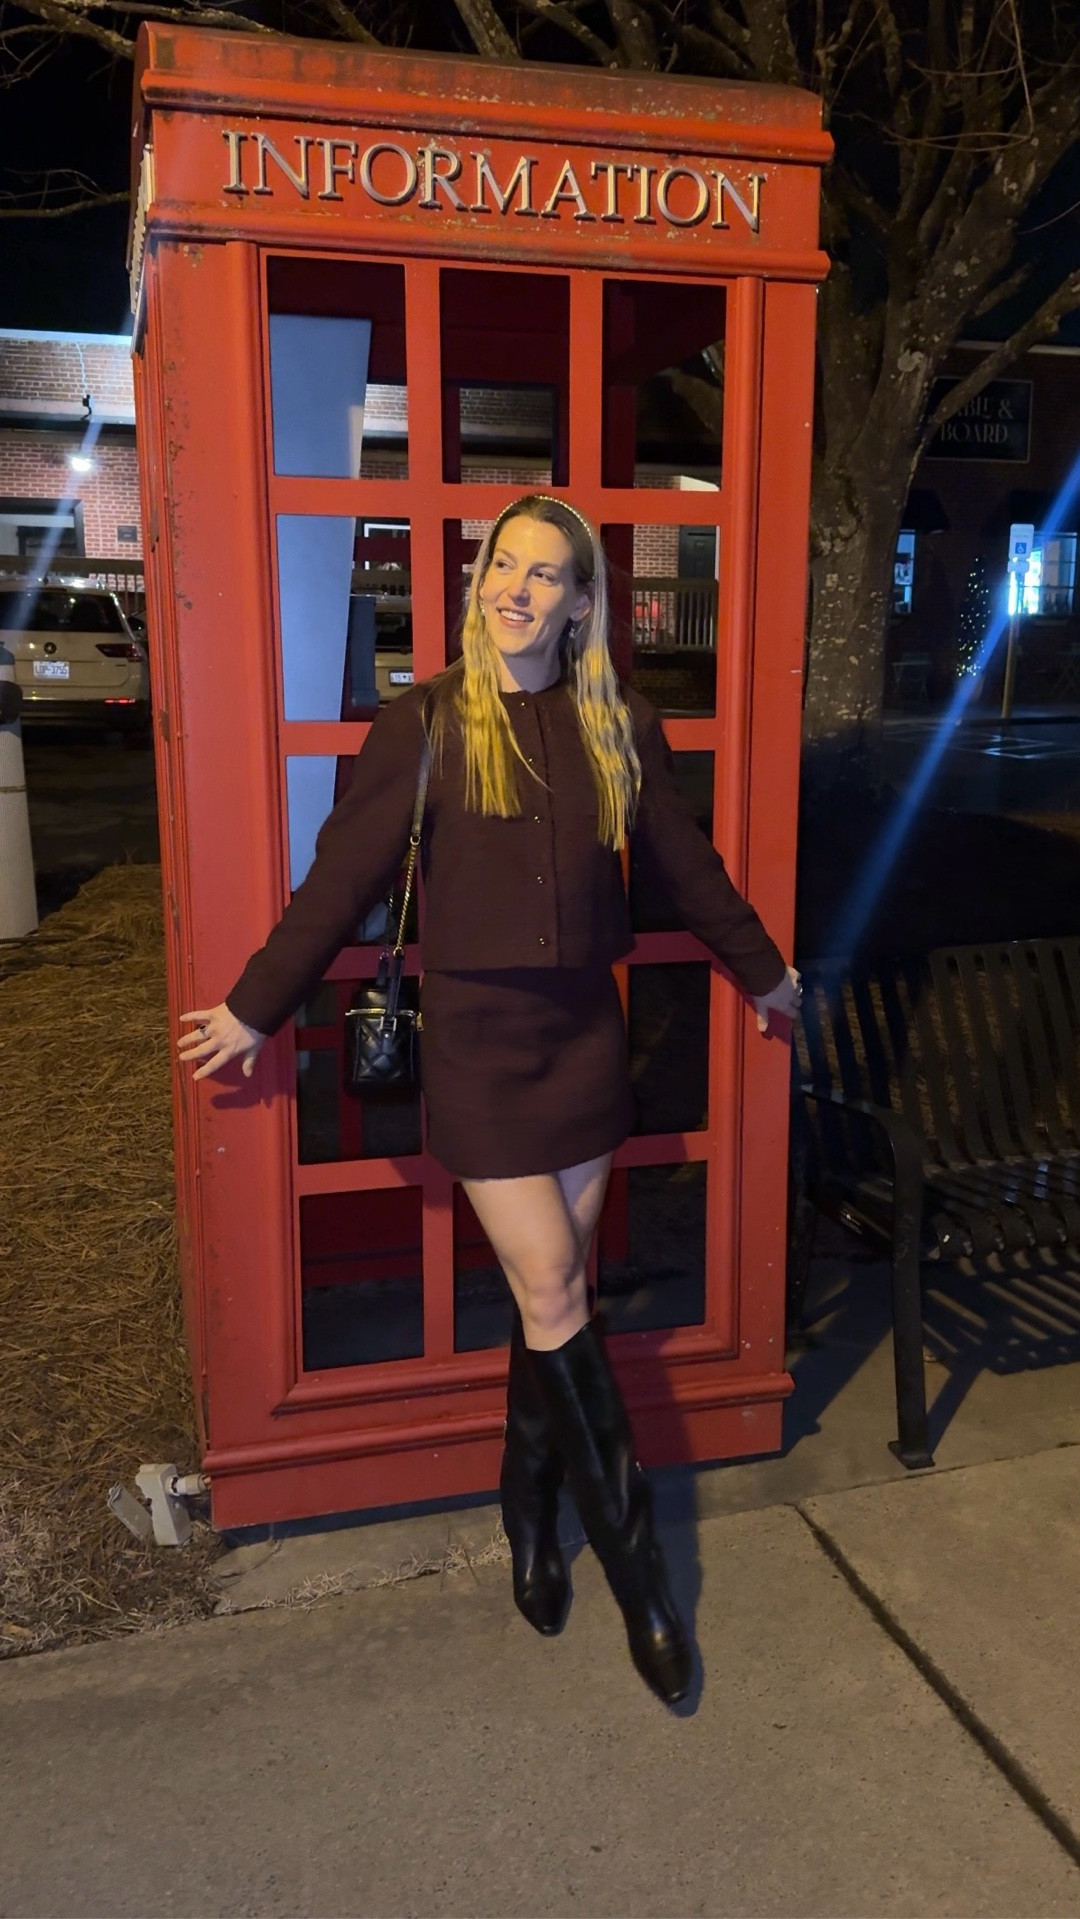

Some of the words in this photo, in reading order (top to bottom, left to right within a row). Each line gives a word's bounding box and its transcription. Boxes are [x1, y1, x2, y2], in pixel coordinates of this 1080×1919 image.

[222, 129, 767, 232] INFORMATION
[998, 398, 1014, 419] &
[941, 423, 1008, 443] BOARD
